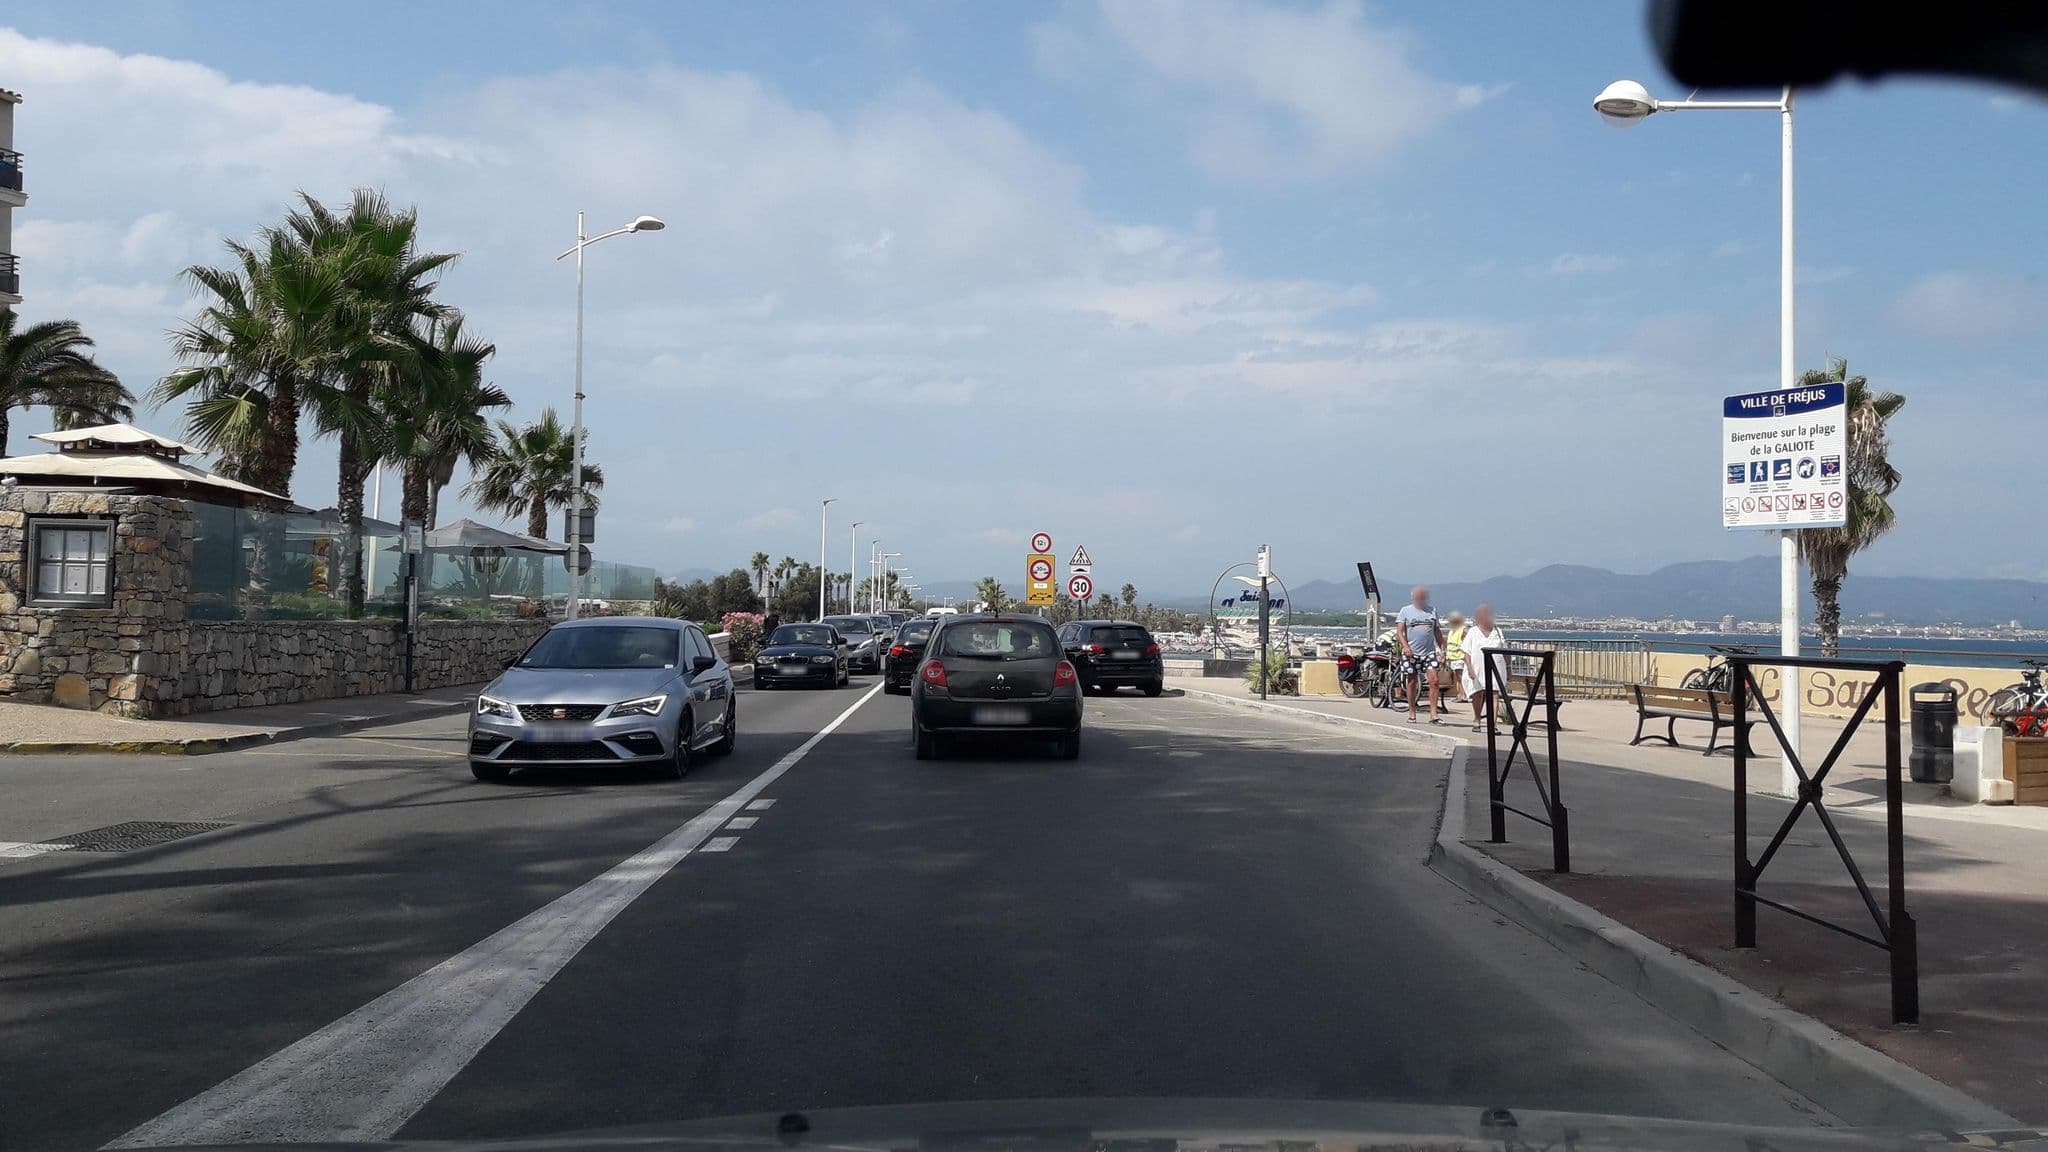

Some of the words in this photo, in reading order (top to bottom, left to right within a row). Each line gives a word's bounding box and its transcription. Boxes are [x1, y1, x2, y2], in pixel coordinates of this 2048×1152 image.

[1741, 396, 1768, 409] VILLE
[1771, 394, 1786, 406] DE
[1788, 389, 1826, 405] FRÉJUS
[1731, 431, 1778, 443] Bienvenue
[1781, 428, 1797, 438] sur
[1798, 425, 1807, 436] la
[1810, 423, 1836, 438] plage
[1750, 445, 1761, 456] de
[1764, 444, 1772, 455] la
[1775, 440, 1815, 453] GALIOTE
[1073, 581, 1087, 593] 30
